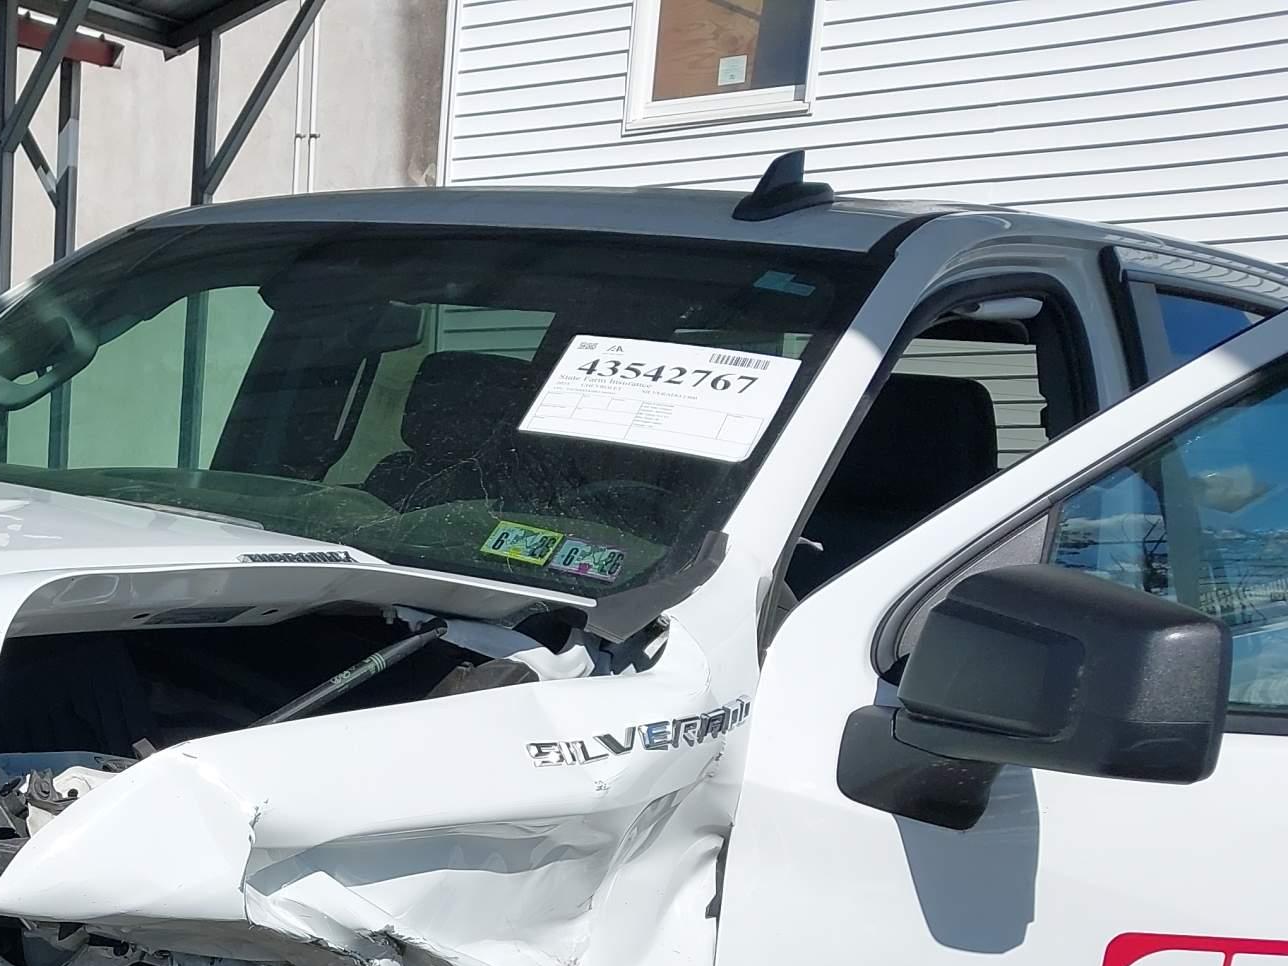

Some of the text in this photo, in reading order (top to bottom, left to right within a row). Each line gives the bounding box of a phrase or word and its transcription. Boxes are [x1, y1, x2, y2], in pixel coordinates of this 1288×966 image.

[577, 358, 759, 395] 43542767
[491, 531, 510, 551] 6
[562, 548, 580, 567] 6
[525, 694, 753, 768] SILVERADO
